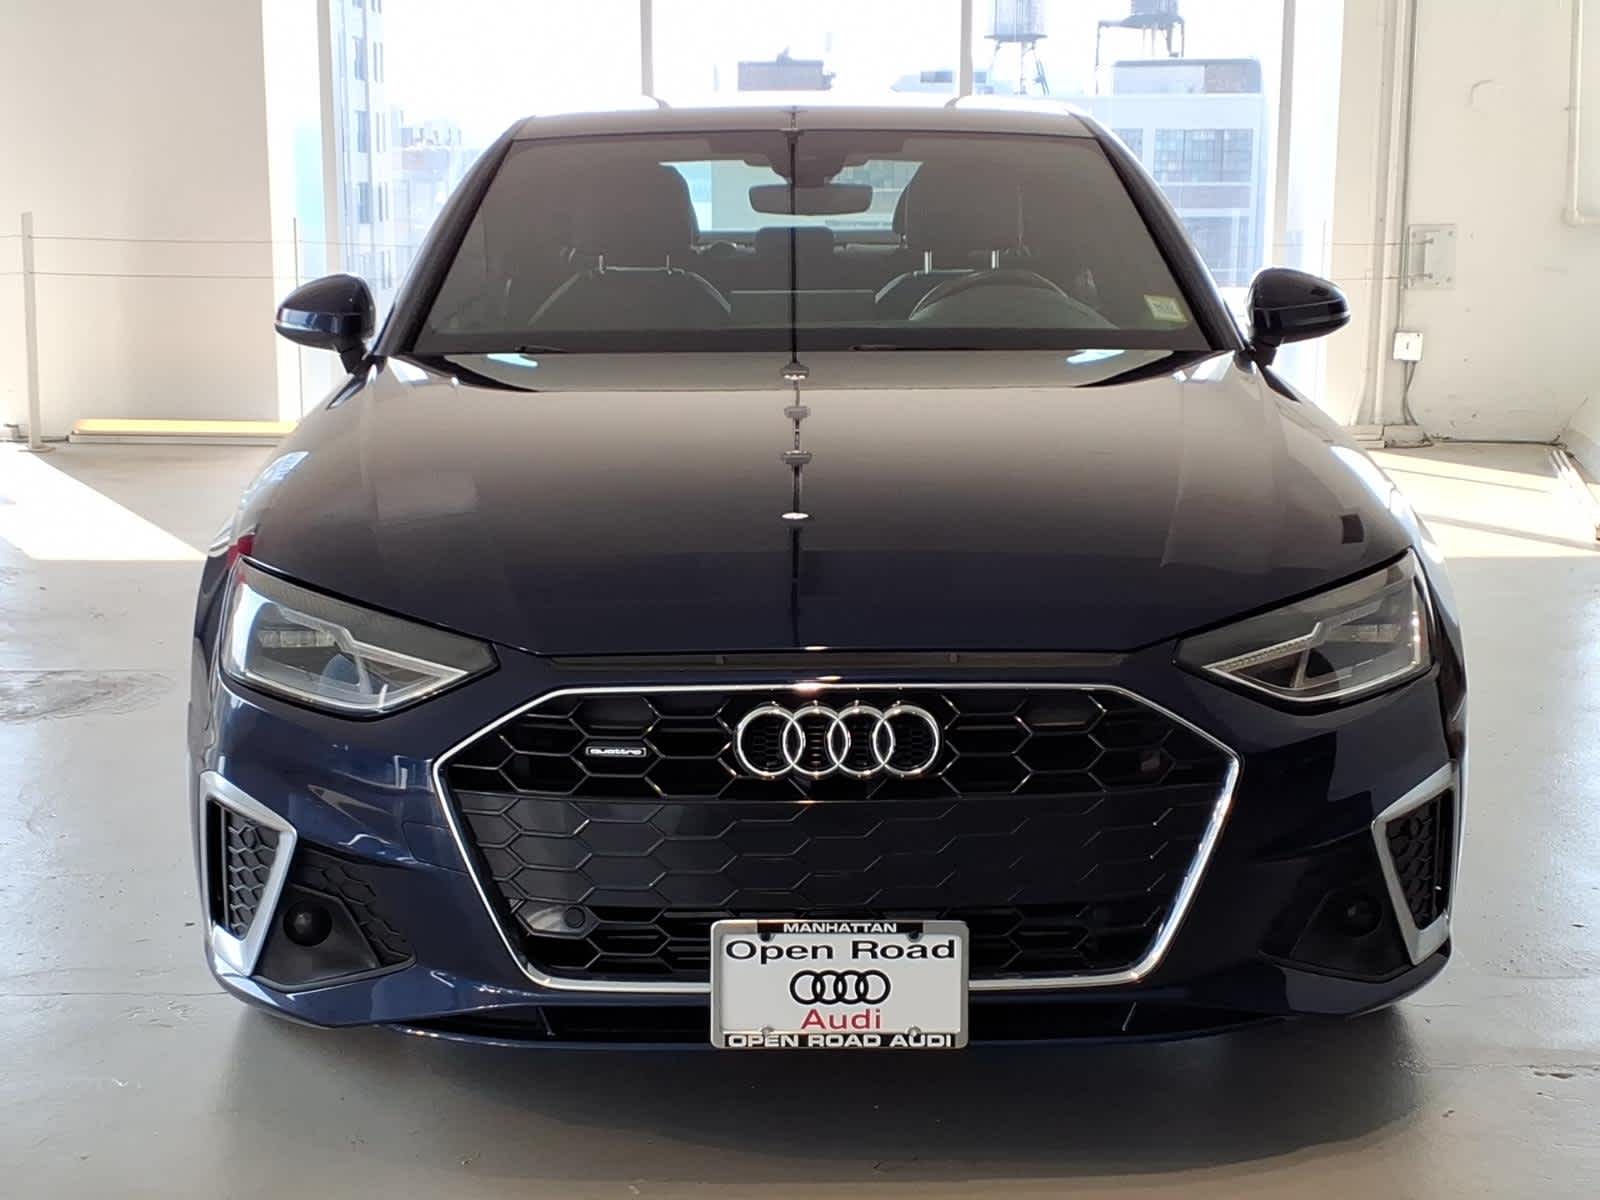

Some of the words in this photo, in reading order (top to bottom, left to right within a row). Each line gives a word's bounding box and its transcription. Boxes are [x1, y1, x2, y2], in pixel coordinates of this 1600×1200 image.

[589, 747, 643, 756] quattro
[783, 923, 898, 933] MANHATTAN
[726, 940, 833, 964] Open
[851, 940, 955, 959] Road
[801, 1009, 881, 1029] Audi
[728, 1034, 800, 1047] OPEN
[808, 1034, 881, 1047] ROAD
[889, 1034, 951, 1047] AUDI
